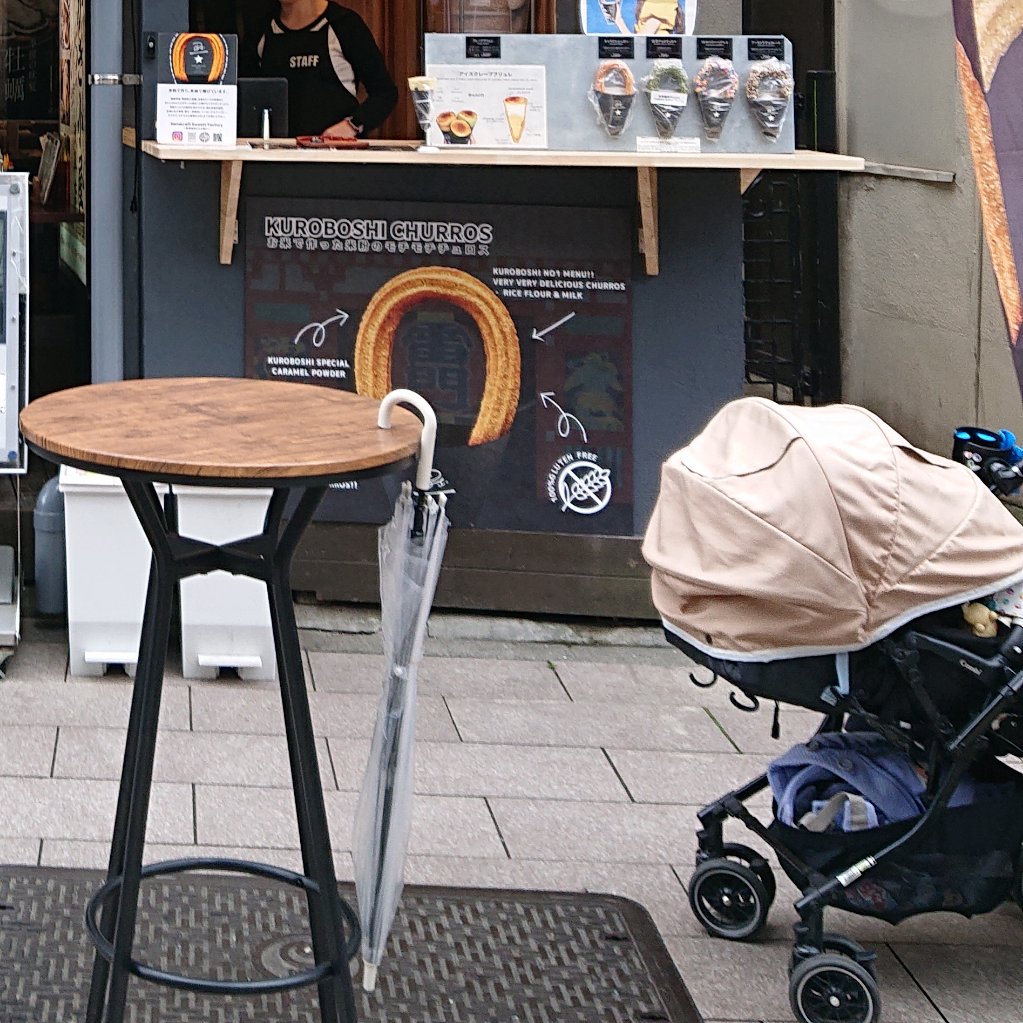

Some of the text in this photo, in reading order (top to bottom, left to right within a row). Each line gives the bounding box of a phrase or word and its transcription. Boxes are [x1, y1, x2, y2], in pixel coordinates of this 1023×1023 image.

[289, 55, 319, 68] STAFF
[264, 216, 493, 244] KUROBOSHI CHURROS
[267, 237, 490, 256] お米で作った米粉のモチモチチュロス
[492, 267, 541, 276] KUROBOSHI
[492, 278, 626, 291] VERY VERY DELICIOUS CHURROS
[503, 289, 583, 300] RICE FLOUR & MILK
[267, 356, 350, 368] KUROBOSHI SPECIAL
[271, 367, 346, 378] CARAMEL POWDER
[576, 451, 599, 462] FREE
